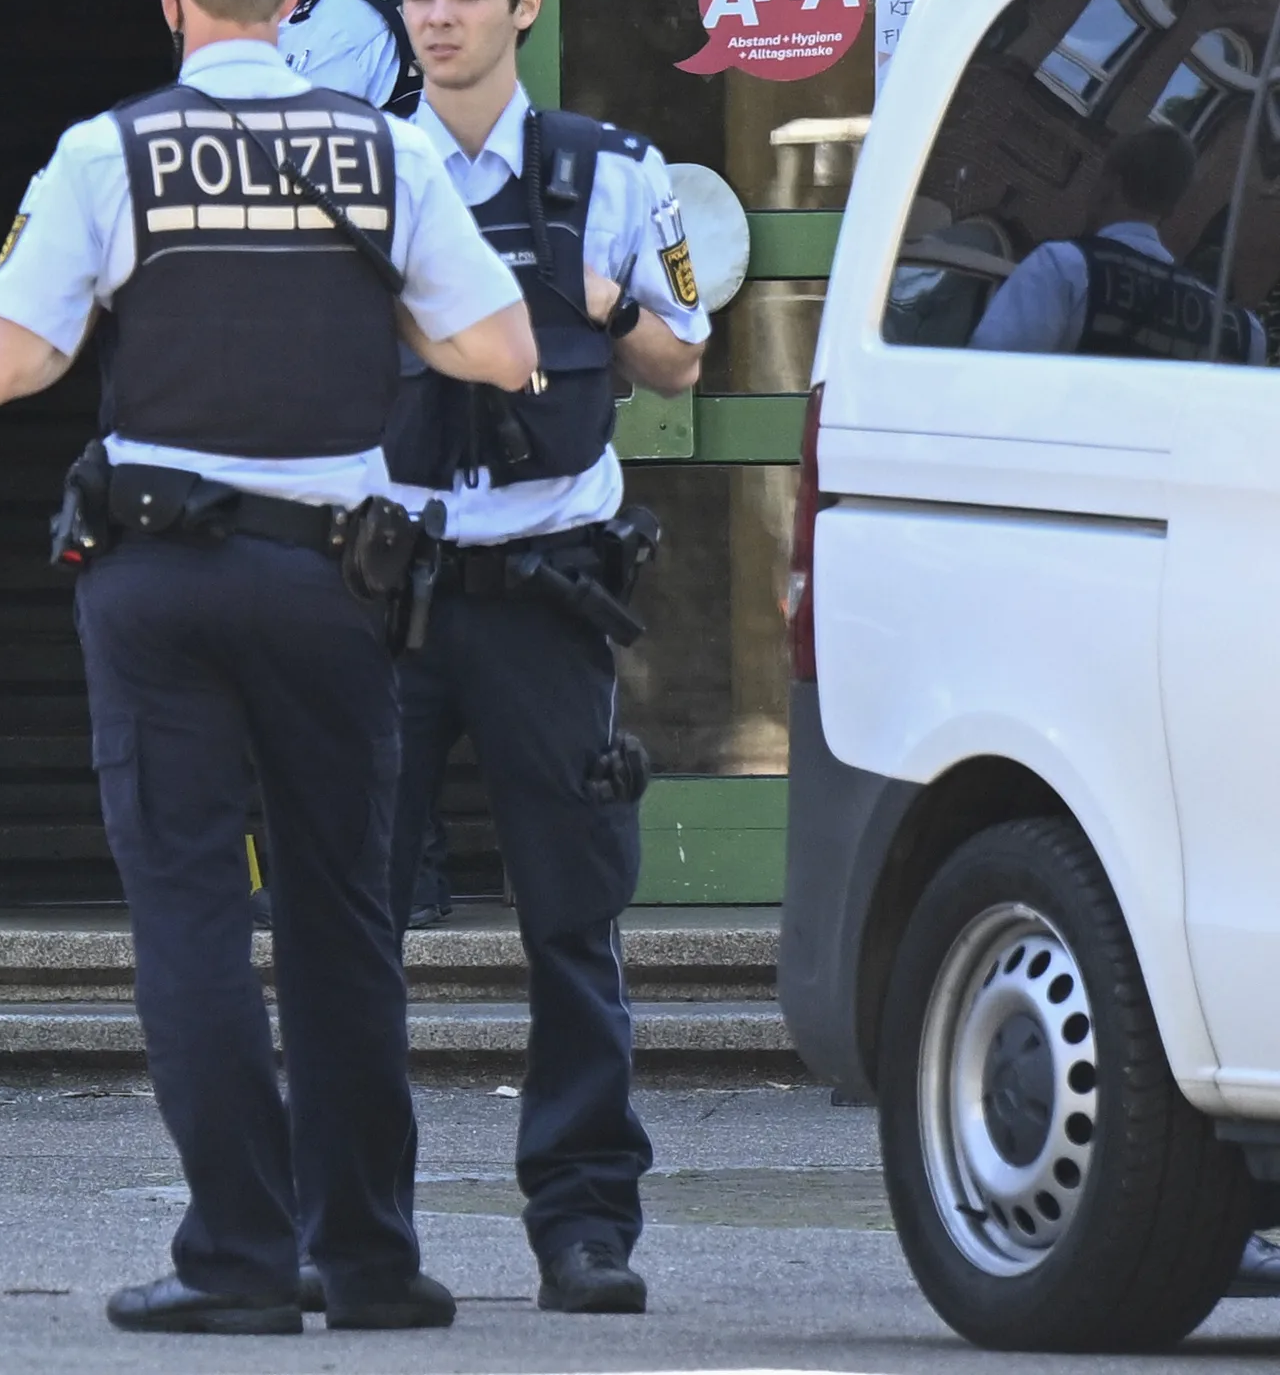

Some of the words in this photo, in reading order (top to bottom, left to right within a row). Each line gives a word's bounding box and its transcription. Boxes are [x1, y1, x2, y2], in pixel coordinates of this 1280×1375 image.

[889, 0, 914, 16] KI
[727, 34, 782, 49] Abstand
[791, 31, 843, 47] Hygiene
[747, 45, 834, 61] Alltagsmaske
[147, 134, 383, 198] POLIZEI
